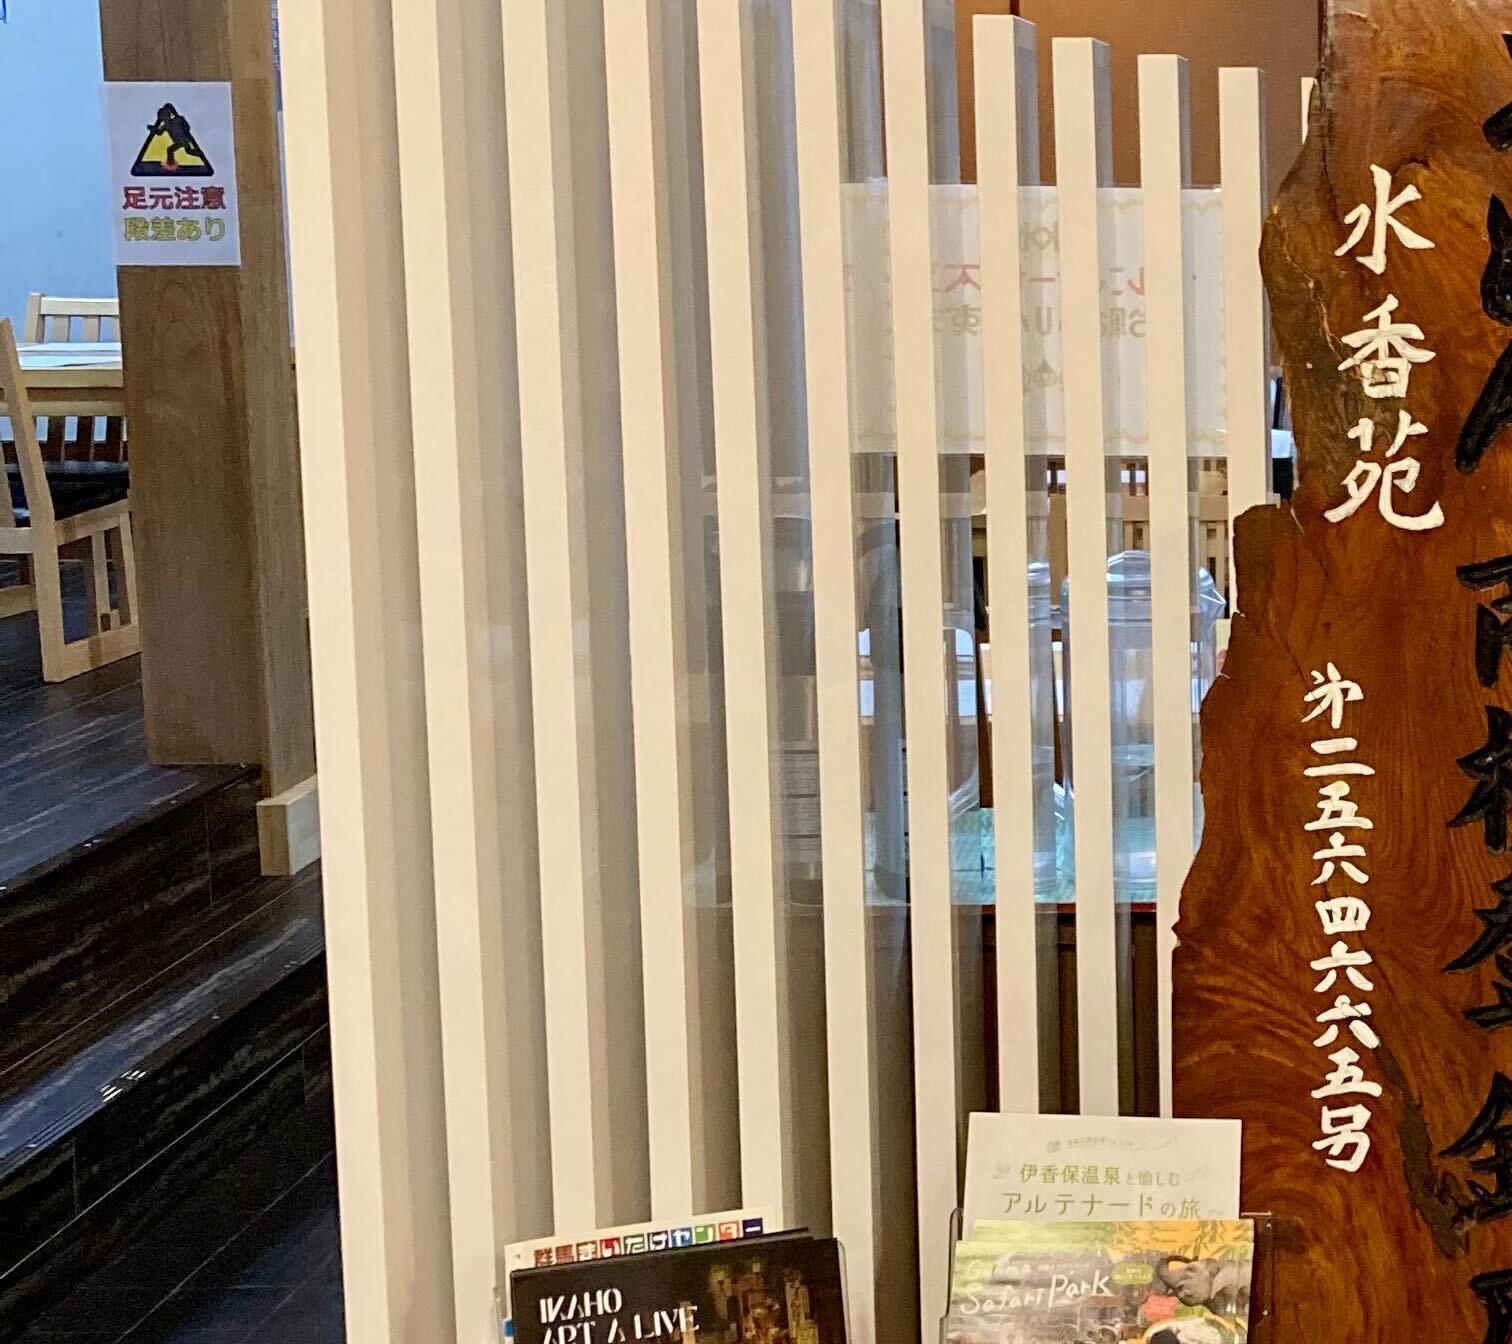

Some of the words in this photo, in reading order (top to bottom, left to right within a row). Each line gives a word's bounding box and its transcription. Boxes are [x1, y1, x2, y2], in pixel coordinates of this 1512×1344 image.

[122, 185, 226, 210] 足元注意
[123, 216, 226, 241] 段差あり
[1323, 163, 1446, 534] 水香苑
[1001, 1192, 1201, 1219] アルテナードの旅
[539, 1287, 623, 1324] IKAHO
[960, 1285, 1043, 1314] Safari
[1048, 1269, 1116, 1312] Park
[607, 1318, 627, 1344] A
[633, 1305, 700, 1340] LIVE
